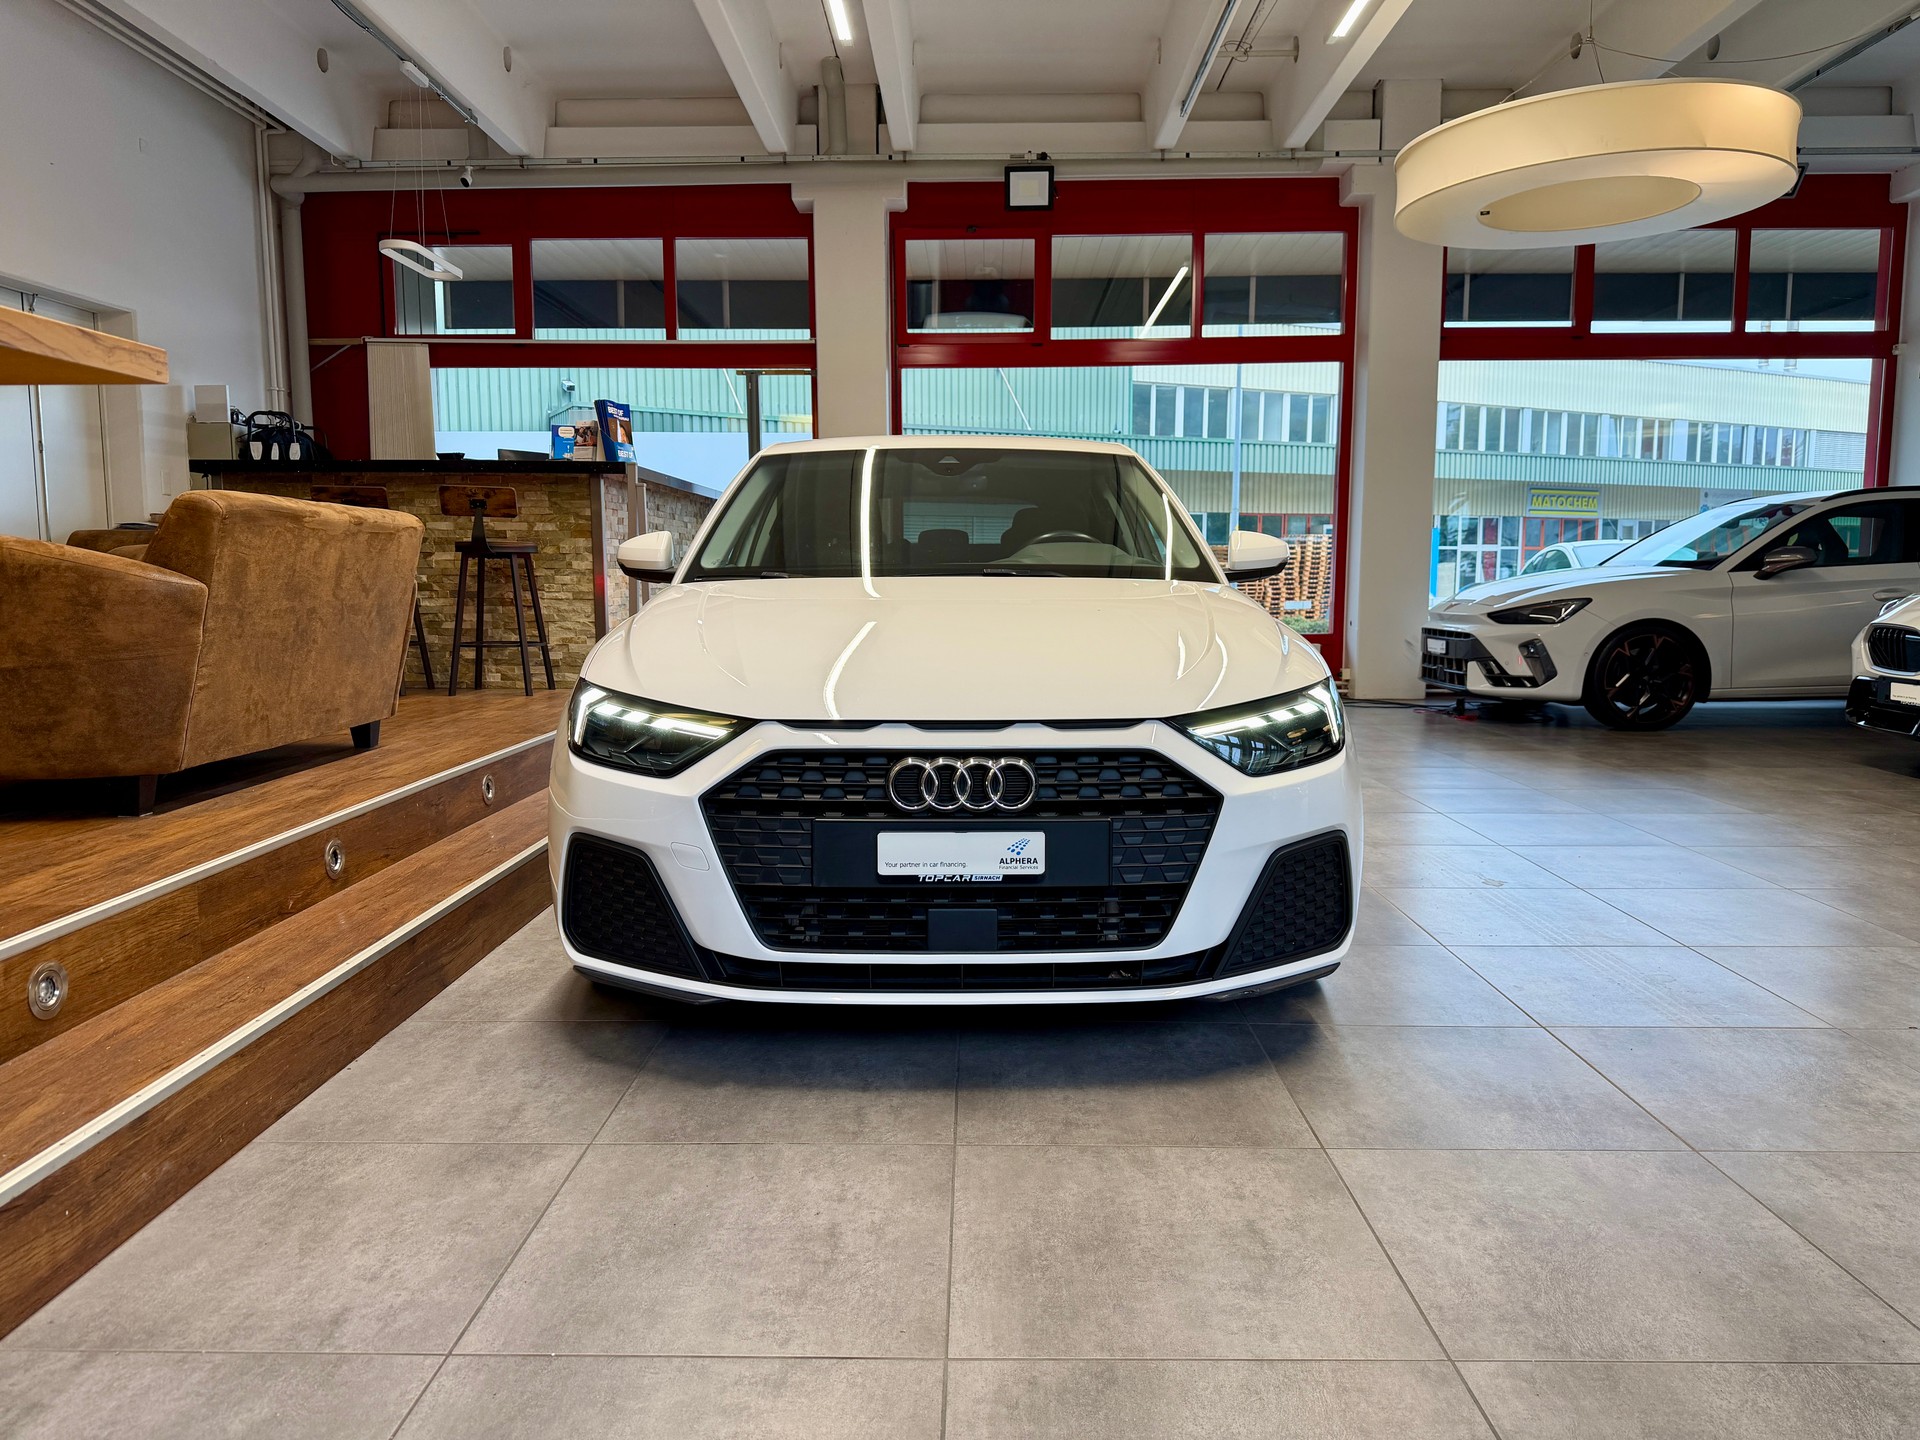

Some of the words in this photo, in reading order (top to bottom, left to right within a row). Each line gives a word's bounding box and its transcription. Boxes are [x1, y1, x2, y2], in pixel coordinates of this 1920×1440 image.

[1532, 495, 1598, 509] MATOCHEM
[899, 861, 920, 869] partner
[999, 857, 1039, 865] ALPHERA
[918, 873, 971, 882] TOPCAR
